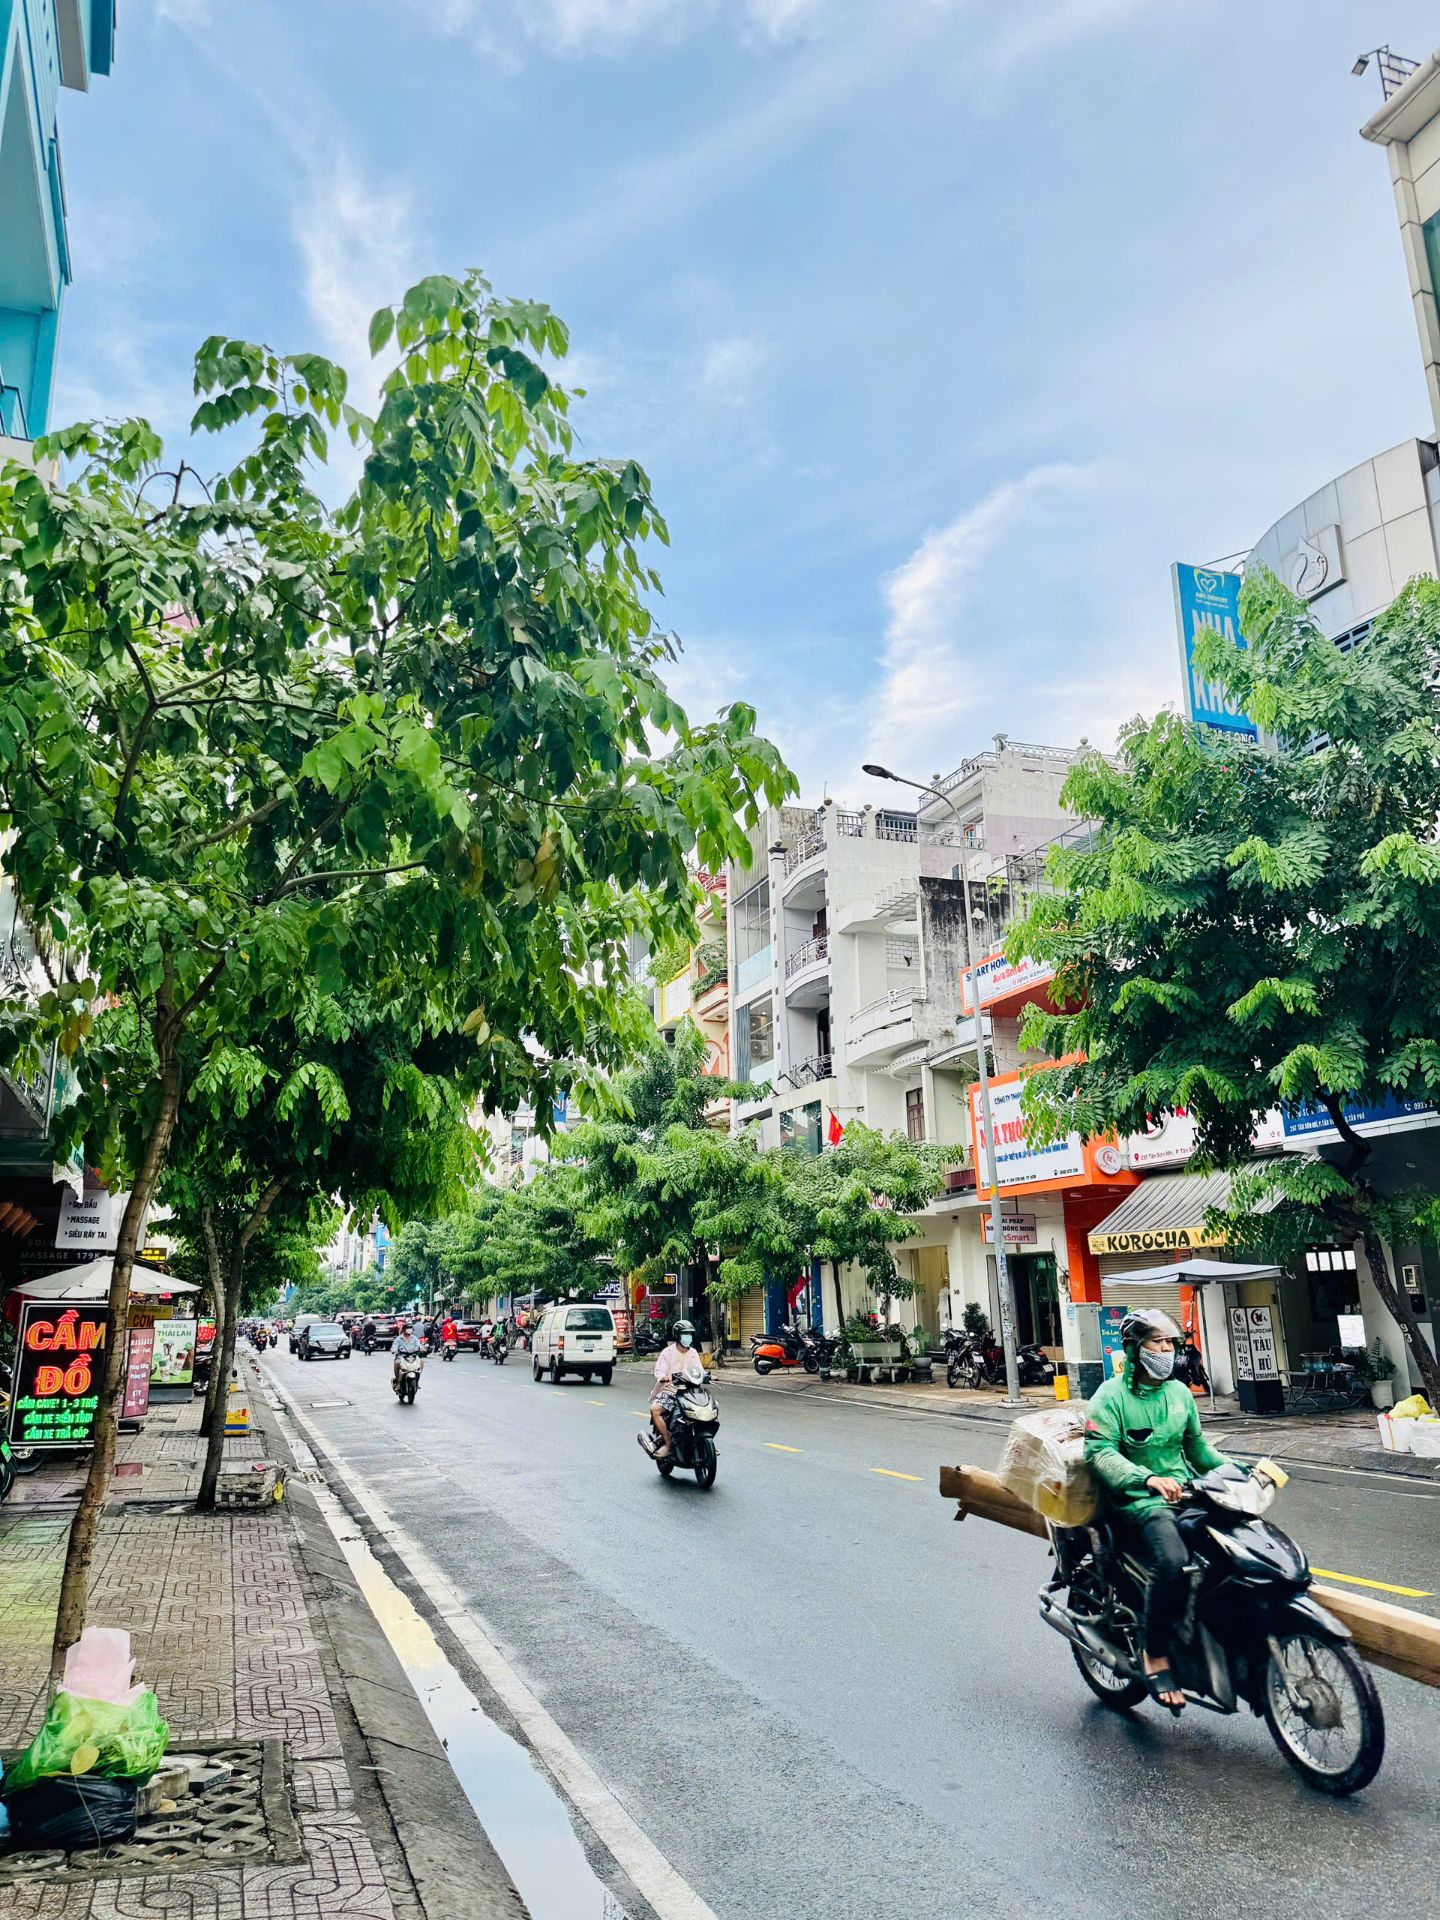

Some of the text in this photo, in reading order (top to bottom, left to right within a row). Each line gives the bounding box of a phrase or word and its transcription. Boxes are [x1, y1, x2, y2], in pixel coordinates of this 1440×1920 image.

[965, 964, 989, 982] SART
[70, 1216, 100, 1224] MASSAGE
[97, 1231, 107, 1239] TAI
[1107, 1230, 1190, 1251] KUROCHA
[1253, 1336, 1272, 1351] TÀU
[36, 1354, 92, 1395] ĐỒ
[81, 1395, 98, 1409] TRIỆ
